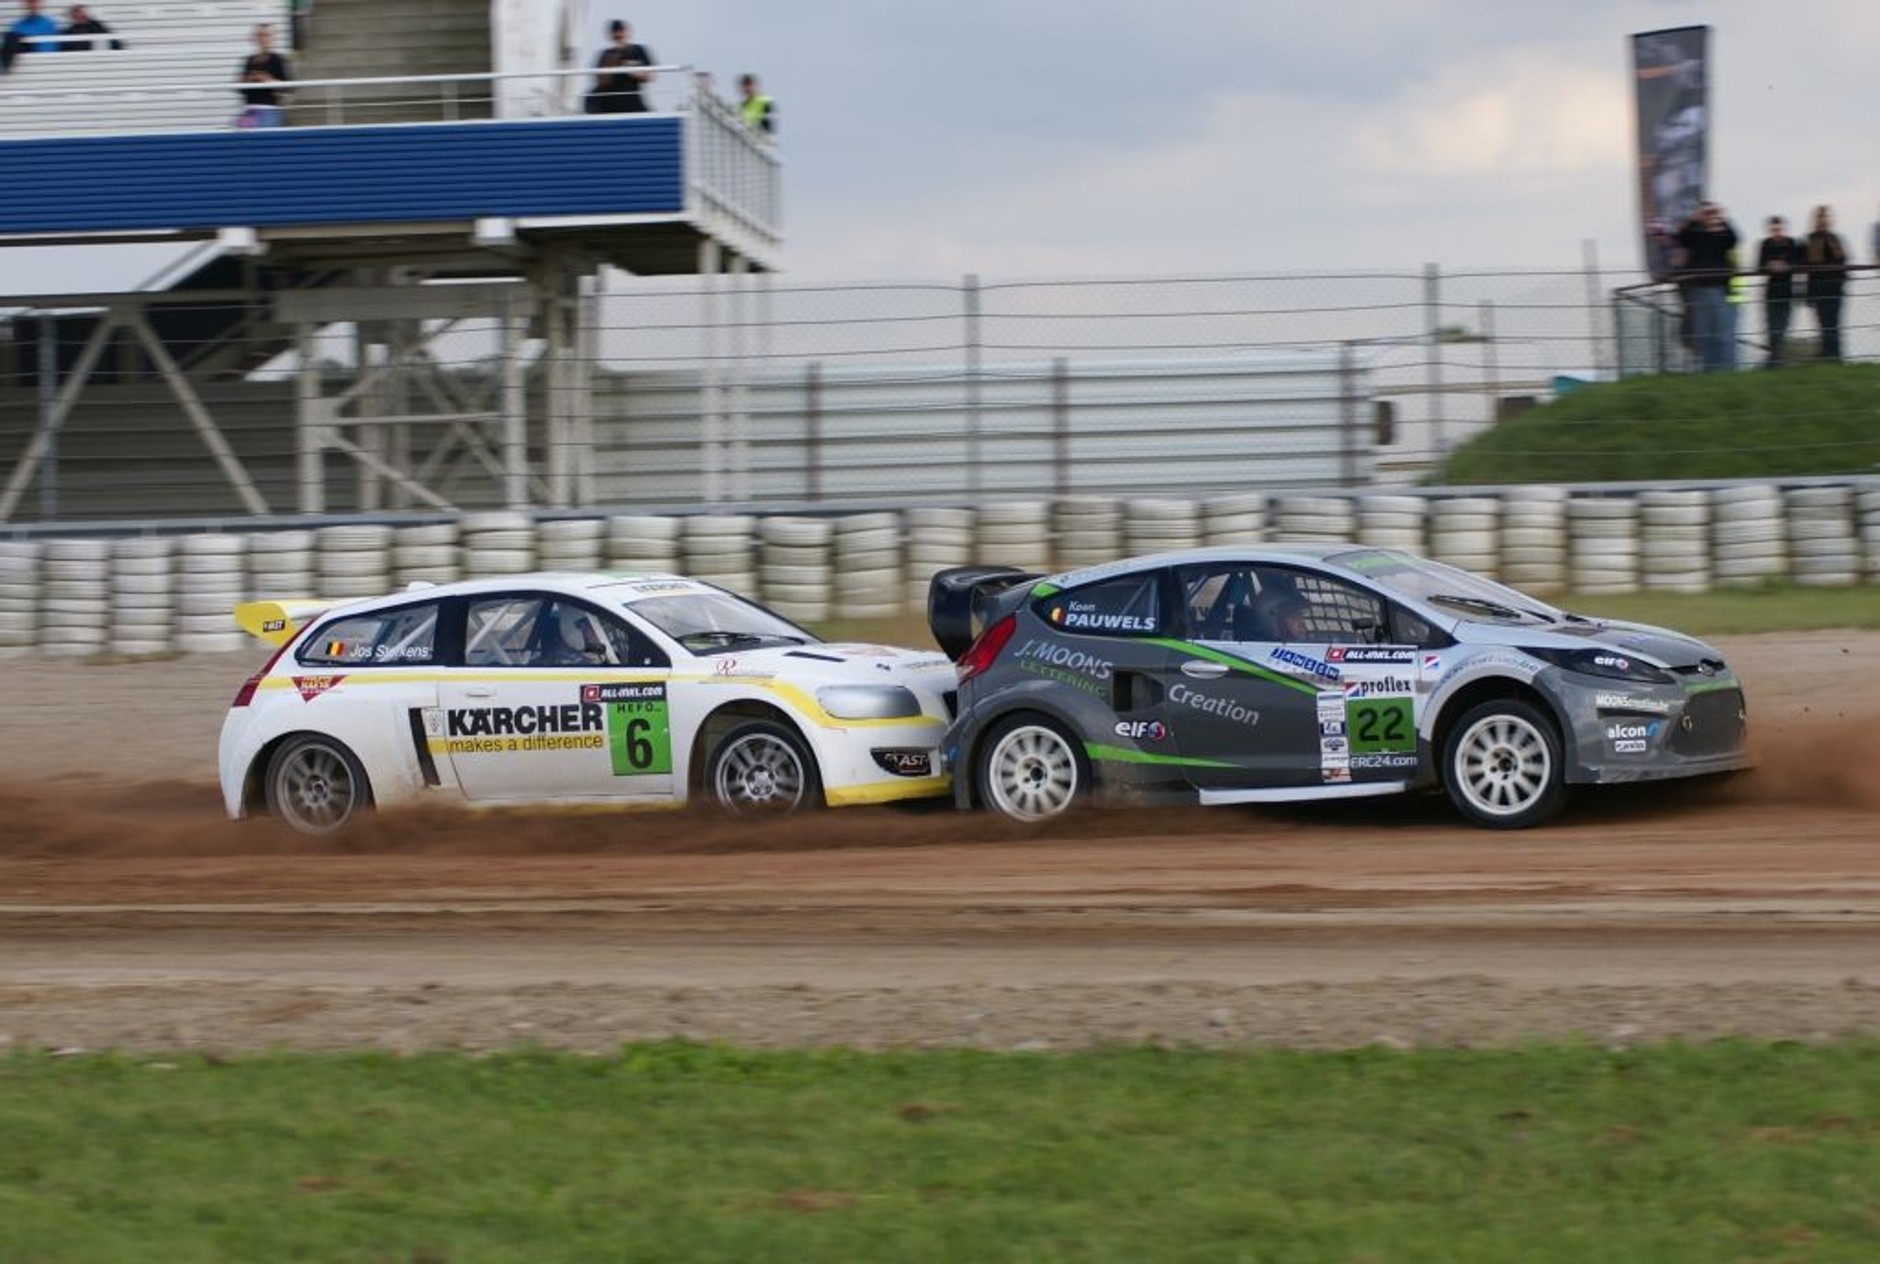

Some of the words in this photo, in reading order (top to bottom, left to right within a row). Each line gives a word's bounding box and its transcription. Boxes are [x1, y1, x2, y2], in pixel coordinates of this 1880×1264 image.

[1064, 613, 1156, 630] PAUWELS
[349, 643, 372, 658] Jos
[1360, 675, 1412, 697] proflex
[1169, 683, 1260, 726] Creation
[448, 703, 604, 737] KÄRCHER
[1115, 721, 1149, 738] elf
[1357, 706, 1406, 741] 22
[1608, 724, 1647, 738] alcon
[450, 737, 501, 752] makes
[508, 740, 518, 750] a
[523, 735, 604, 750] difference
[626, 718, 654, 769] 6
